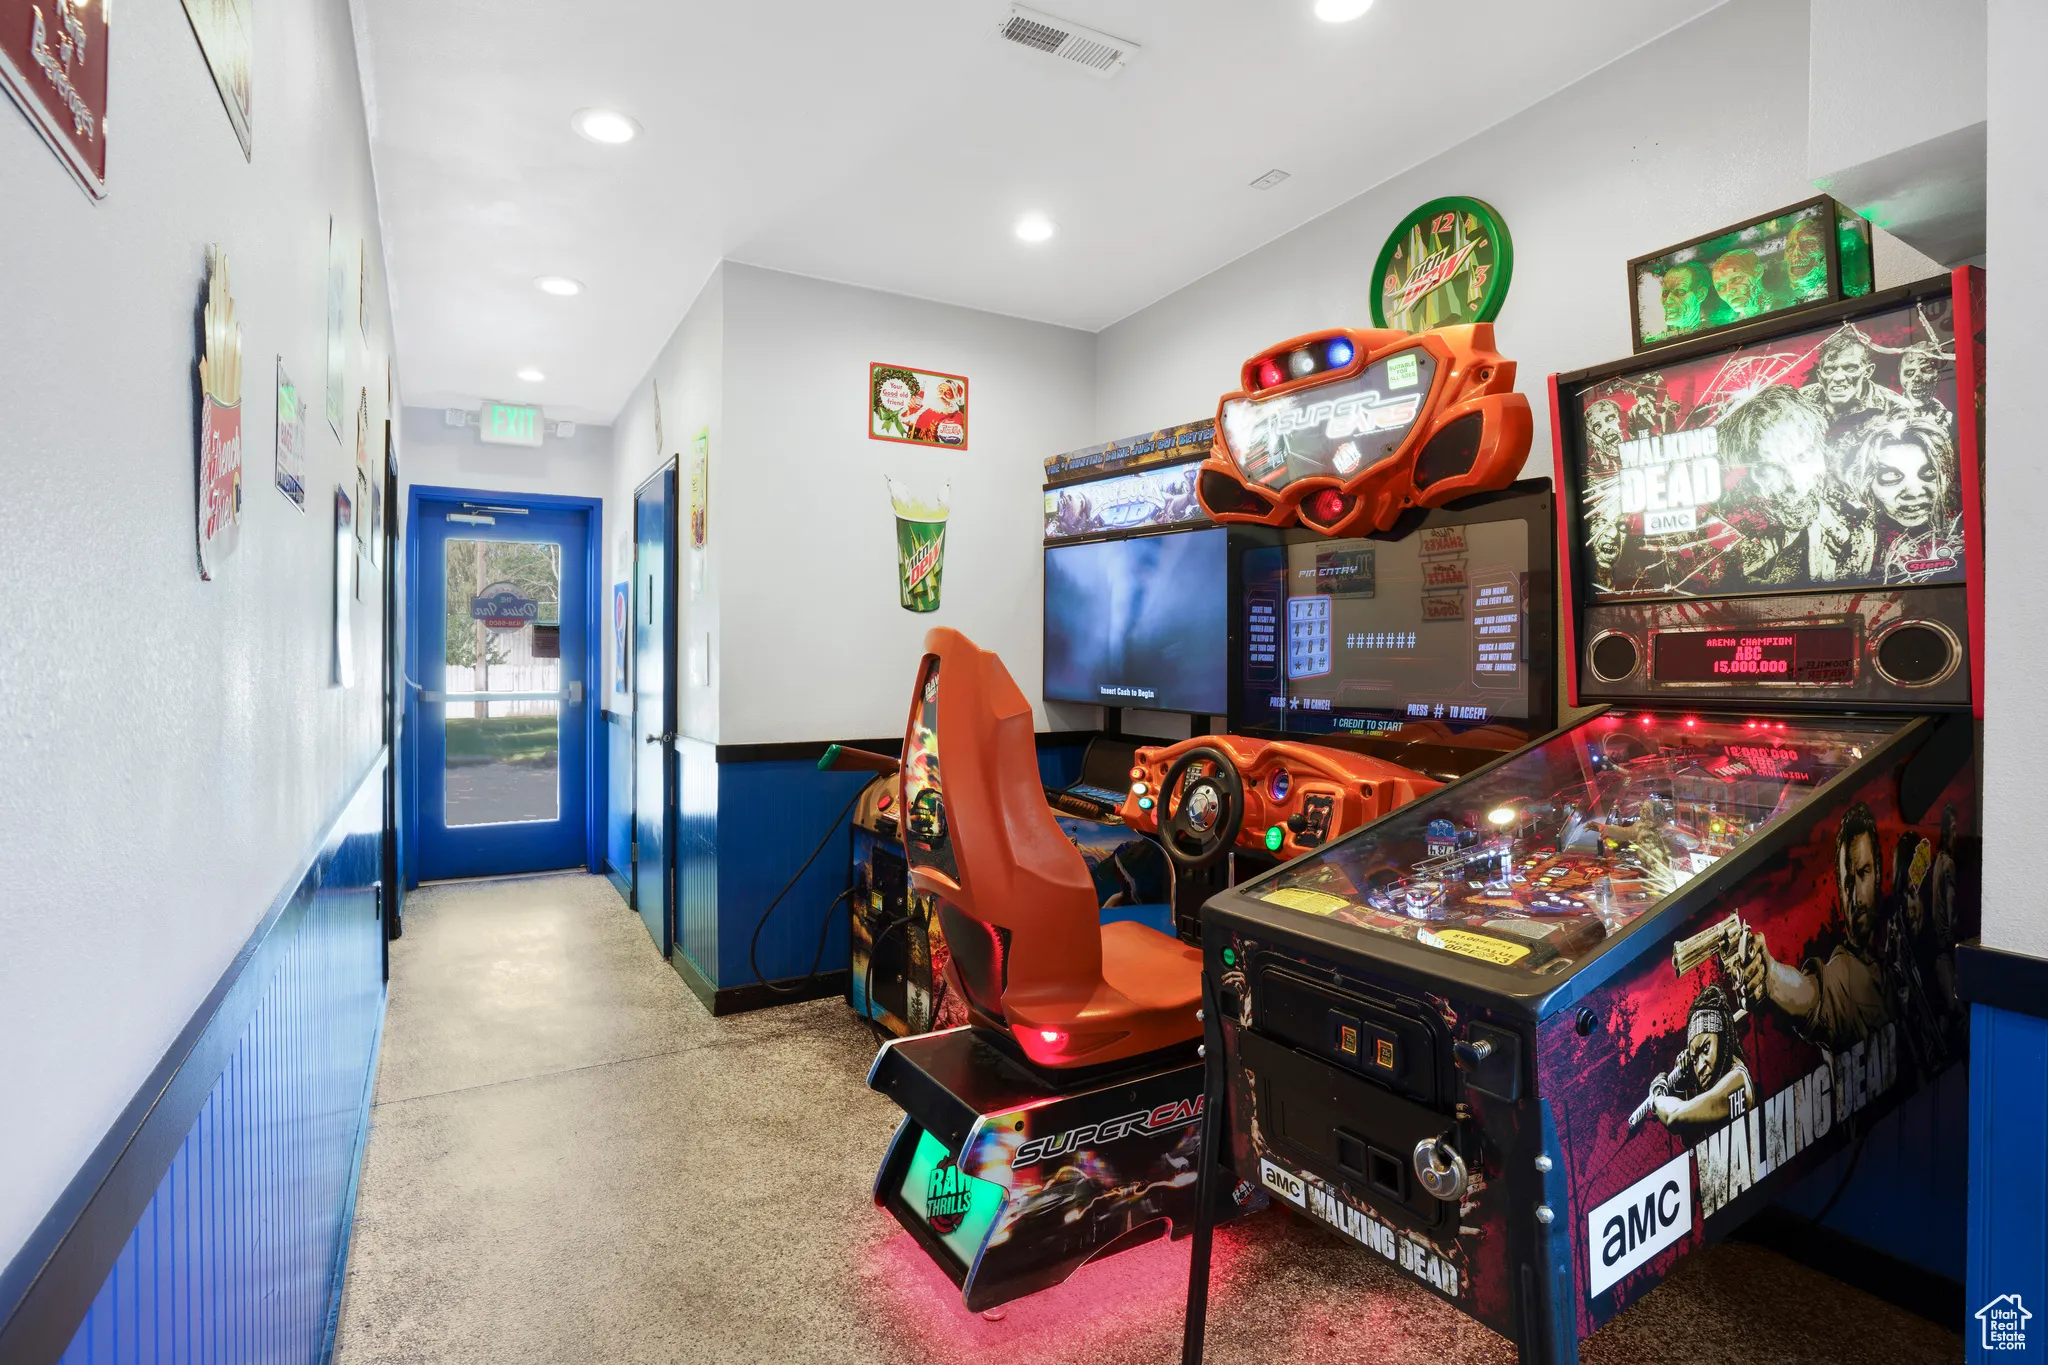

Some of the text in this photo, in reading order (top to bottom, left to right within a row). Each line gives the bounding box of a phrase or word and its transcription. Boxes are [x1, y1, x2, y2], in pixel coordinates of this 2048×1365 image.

[1432, 213, 1455, 234] 12
[1472, 265, 1488, 288] 3
[1385, 275, 1397, 295] 9
[1388, 360, 1414, 371] SUITABLE
[1390, 371, 1416, 382] ALL AGES
[882, 389, 898, 398] Good
[887, 398, 904, 407] friend
[1276, 391, 1380, 435] SUPER
[492, 405, 536, 440] EXIT
[1047, 464, 1060, 475] THE
[1069, 452, 1103, 468] HUNTING
[1105, 446, 1130, 461] GAME
[1132, 440, 1156, 455] JUST
[1157, 436, 1177, 450] GOT
[1179, 427, 1215, 445] BETTER
[1618, 426, 1718, 469] WALKING
[1620, 458, 1722, 513] DEAD
[1108, 504, 1151, 524] HD
[911, 535, 942, 586] DEW
[1910, 561, 1951, 571] Stern
[1298, 565, 1358, 578] PIN ENTRY
[1493, 586, 1508, 595] MONEY
[1489, 596, 1502, 605] EVERY
[1295, 601, 1326, 617] 1 2 3
[1484, 615, 1495, 624] YOUR
[1496, 614, 1518, 623] EARNINGS
[1294, 620, 1325, 637] 4 5 6
[1489, 624, 1511, 633] UPGRADES
[1295, 638, 1325, 655] 7 8 9
[1706, 637, 1792, 647] ARENA CHAMPION
[1488, 653, 1500, 661] WITH
[1500, 653, 1512, 661] YOUR
[1735, 646, 1762, 660] ABC
[1307, 657, 1313, 671] 0
[1713, 660, 1788, 674] 15,000,000
[1100, 686, 1154, 699] Insert Cash to Begin
[1269, 697, 1331, 710] PRESS TO CANCEL
[1407, 703, 1487, 719] PRESS # TO ACCEPT
[1333, 718, 1403, 732] 1 CREDIT TO START
[1476, 945, 1517, 958] VALUE
[1729, 1087, 1745, 1119] THE
[1696, 1022, 1898, 1220] WALKING DEAD
[928, 1165, 973, 1199] RAW
[1325, 1184, 1336, 1198] THE
[927, 1192, 972, 1218] THRILLS
[1308, 1185, 1458, 1297] WALKING DEAD
